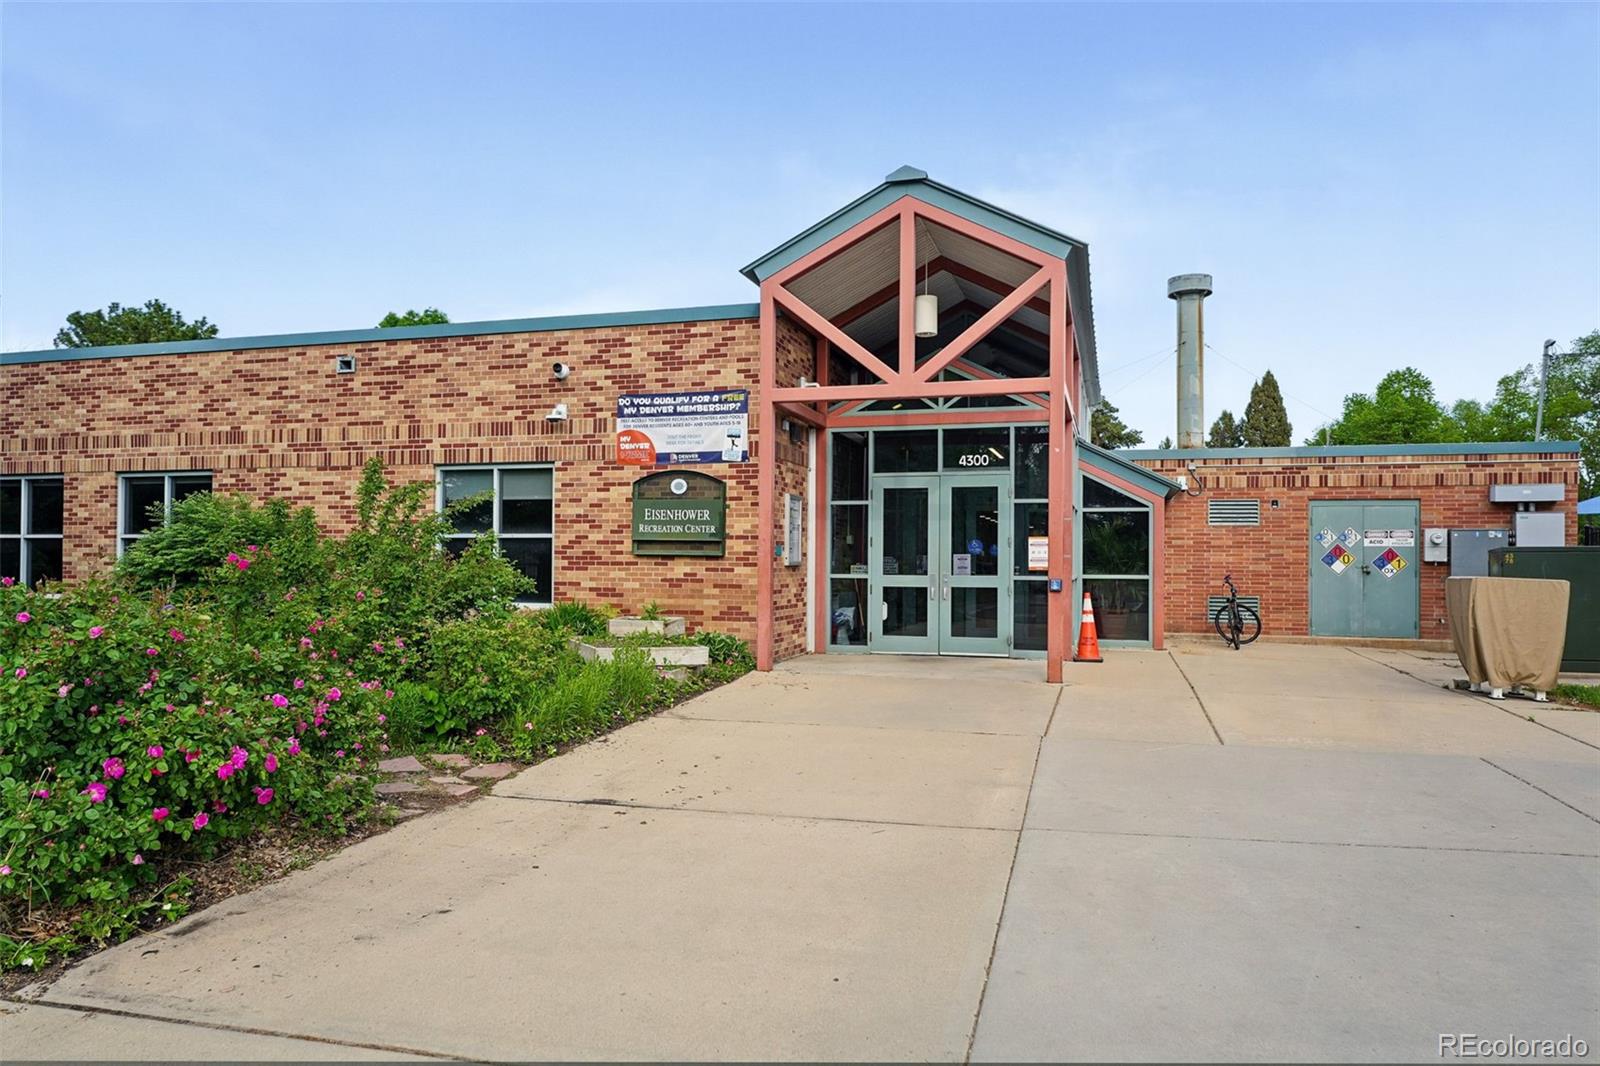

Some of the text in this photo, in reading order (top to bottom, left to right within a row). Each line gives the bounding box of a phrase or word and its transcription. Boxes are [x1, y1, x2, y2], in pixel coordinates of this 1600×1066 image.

[654, 396, 690, 404] QUALIFY
[639, 405, 674, 414] DENVER
[676, 403, 741, 412] MEMBERSHIP?
[959, 455, 989, 466] 4300
[1343, 554, 1350, 564] 0
[1387, 551, 1393, 561] 0
